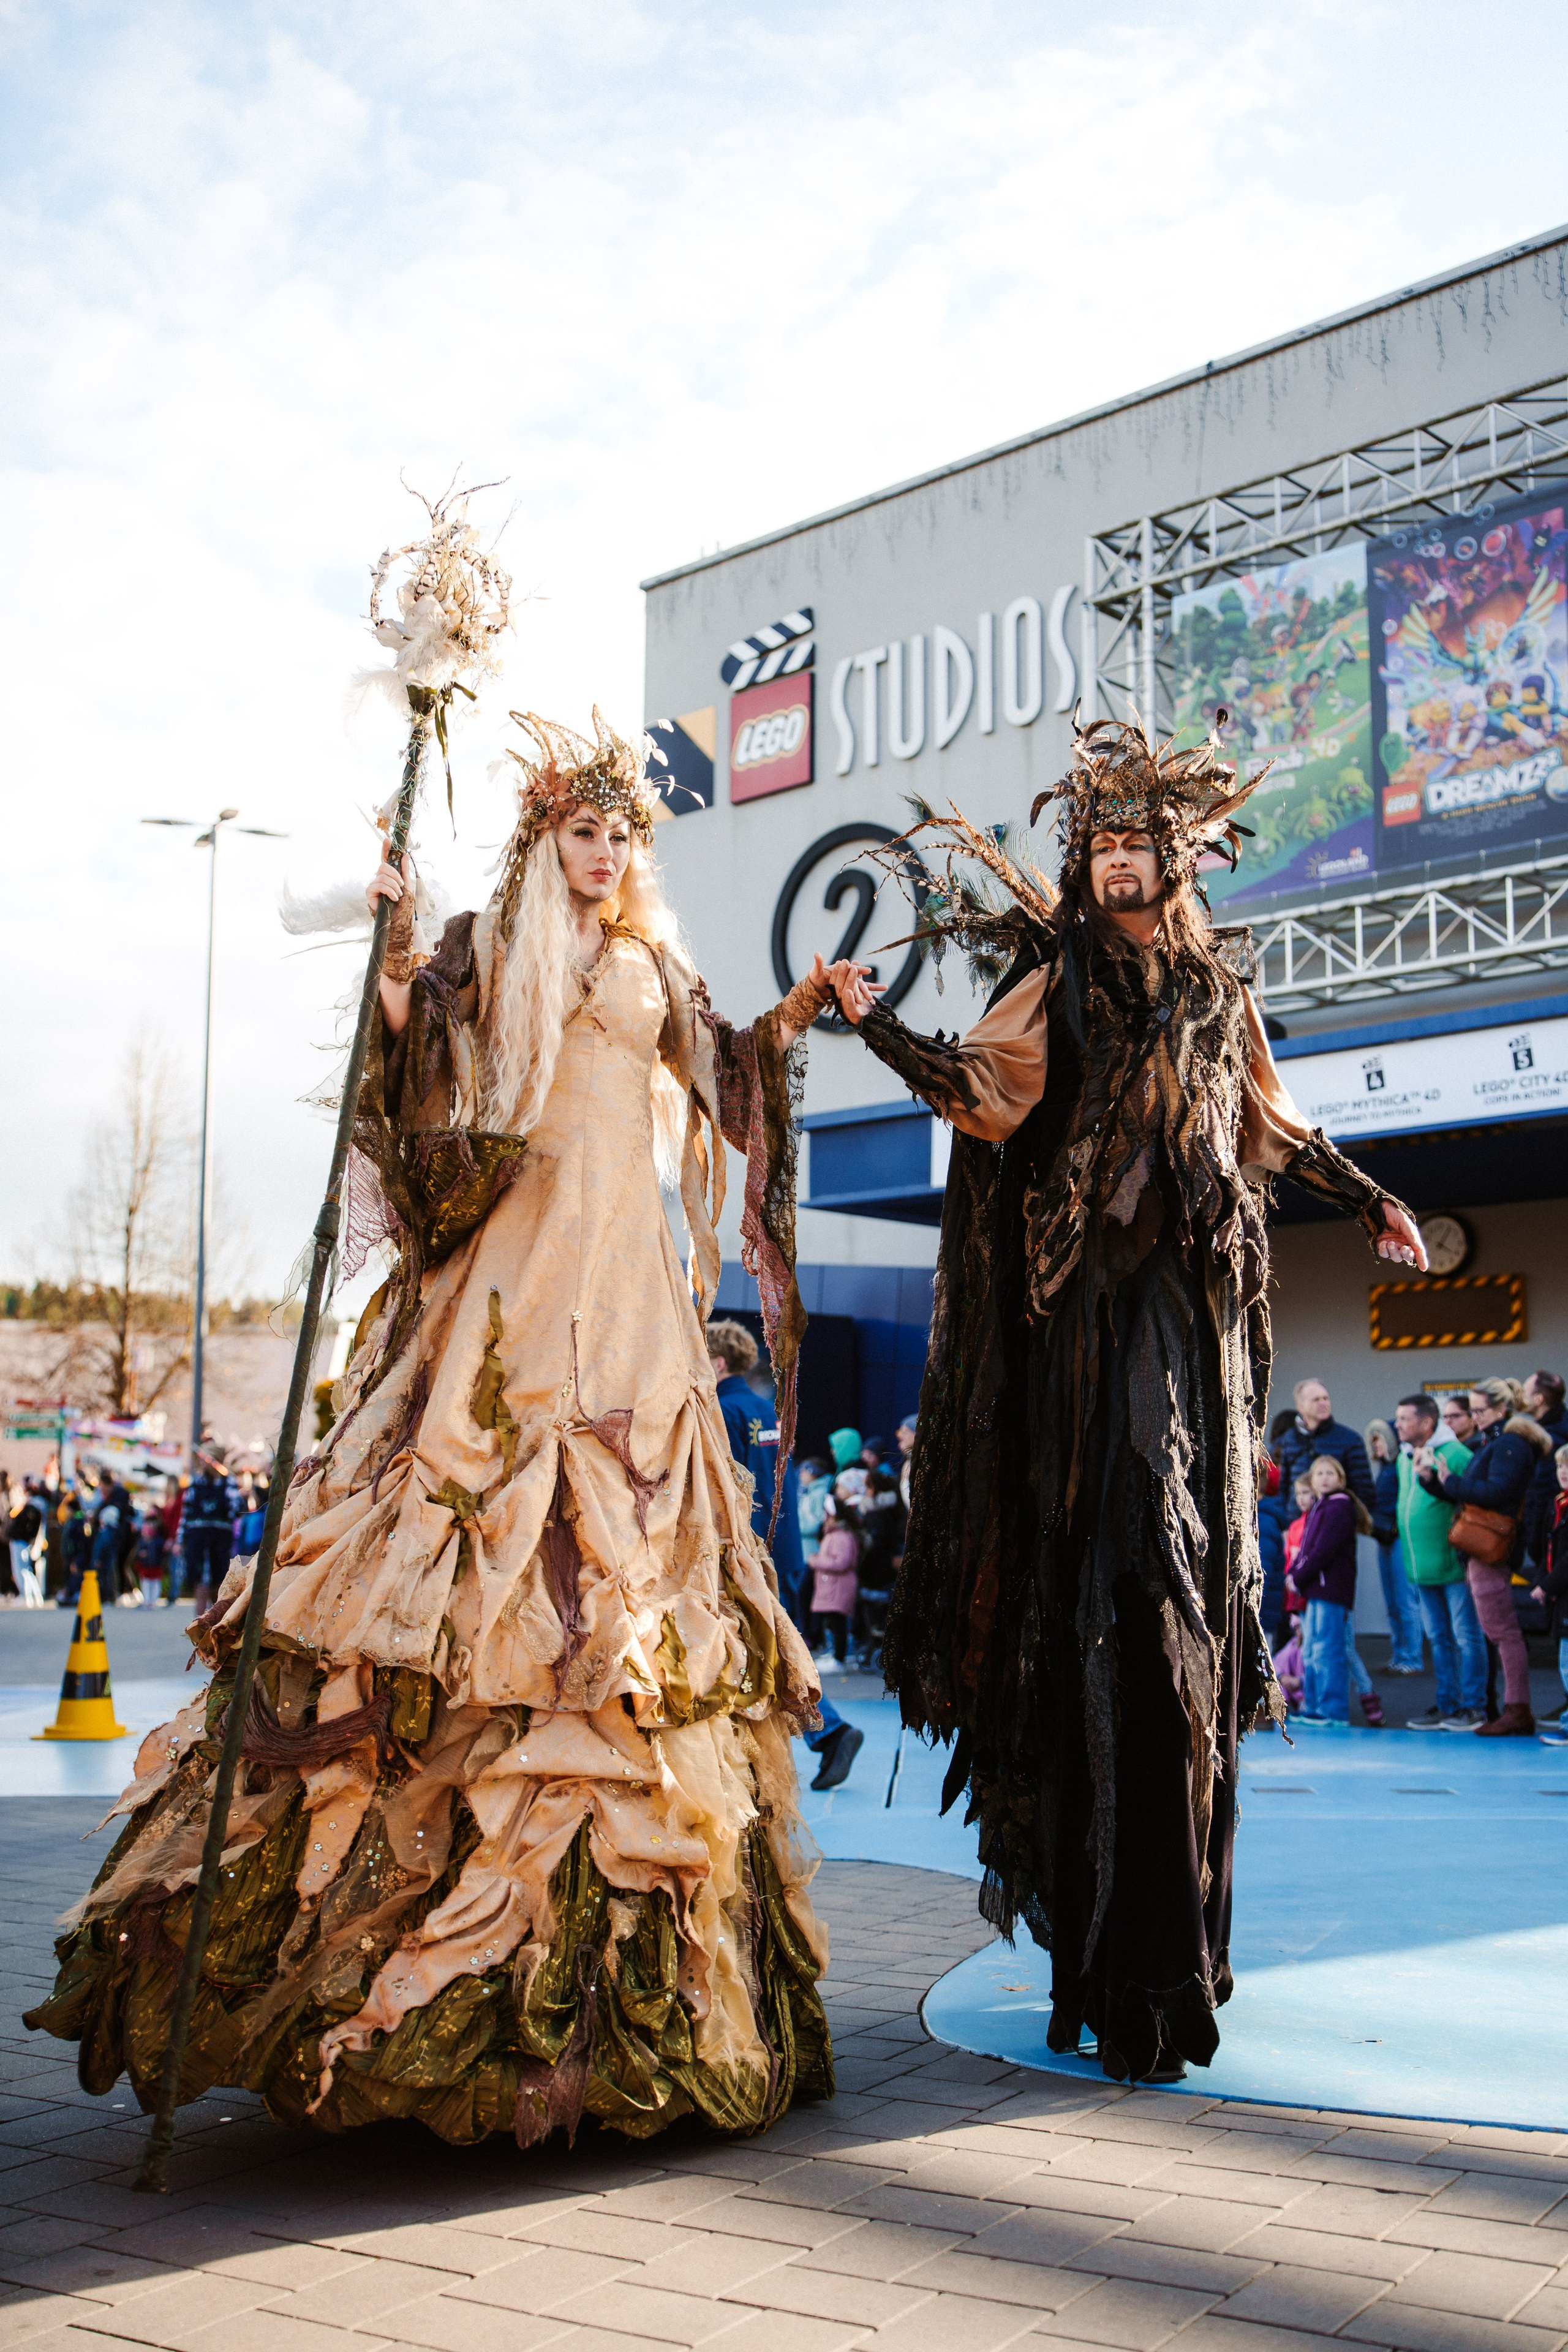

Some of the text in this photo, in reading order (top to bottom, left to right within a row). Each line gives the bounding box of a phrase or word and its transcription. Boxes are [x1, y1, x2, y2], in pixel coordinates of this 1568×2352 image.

[830, 584, 1077, 776] STUDIOS
[736, 708, 805, 766] LEGO
[824, 869, 877, 984] 2
[1517, 1050, 1530, 1069] 5
[1368, 1071, 1382, 1088] 4
[1519, 1073, 1550, 1089] CITY
[1423, 1088, 1441, 1102] 4D
